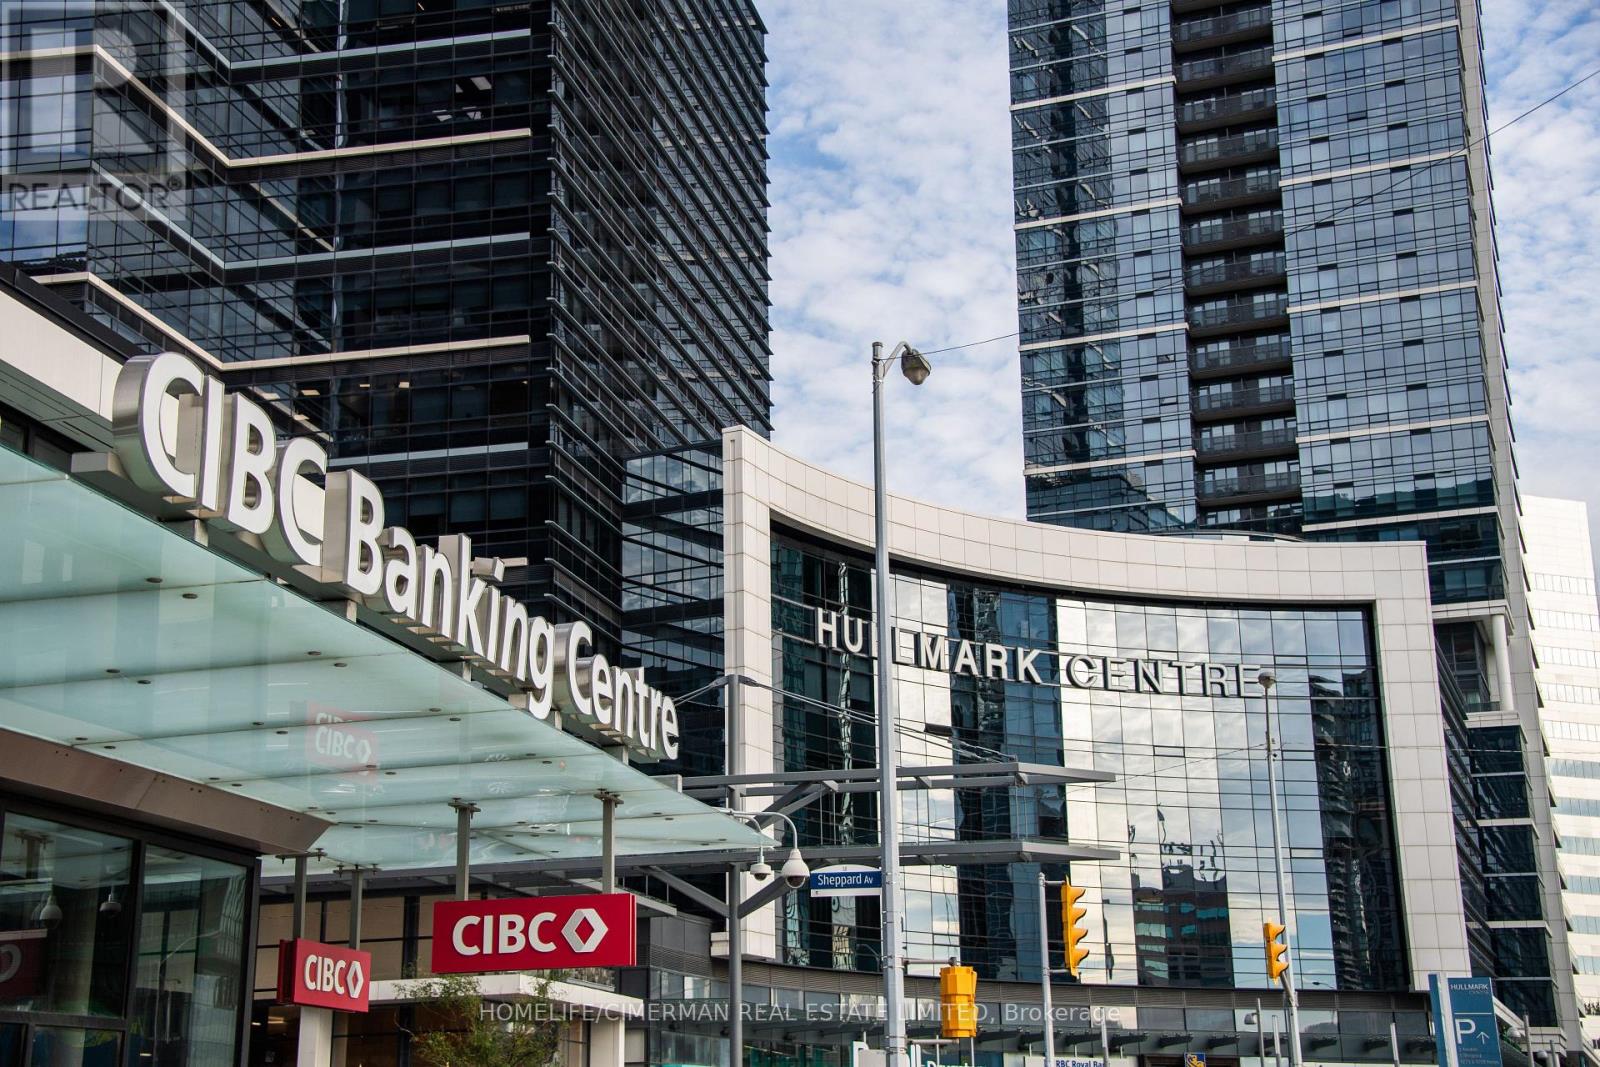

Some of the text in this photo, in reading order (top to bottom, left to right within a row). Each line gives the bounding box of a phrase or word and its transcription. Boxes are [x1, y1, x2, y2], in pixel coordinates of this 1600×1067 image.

[136, 351, 679, 761] CIBC Banking Centre
[1066, 654, 1264, 698] CENTRE
[817, 873, 873, 887] Sheppard Av
[452, 911, 557, 956] CIBC
[303, 953, 346, 995] CIBC
[1450, 983, 1489, 991] HULLMARK
[1455, 1018, 1476, 1044] P
